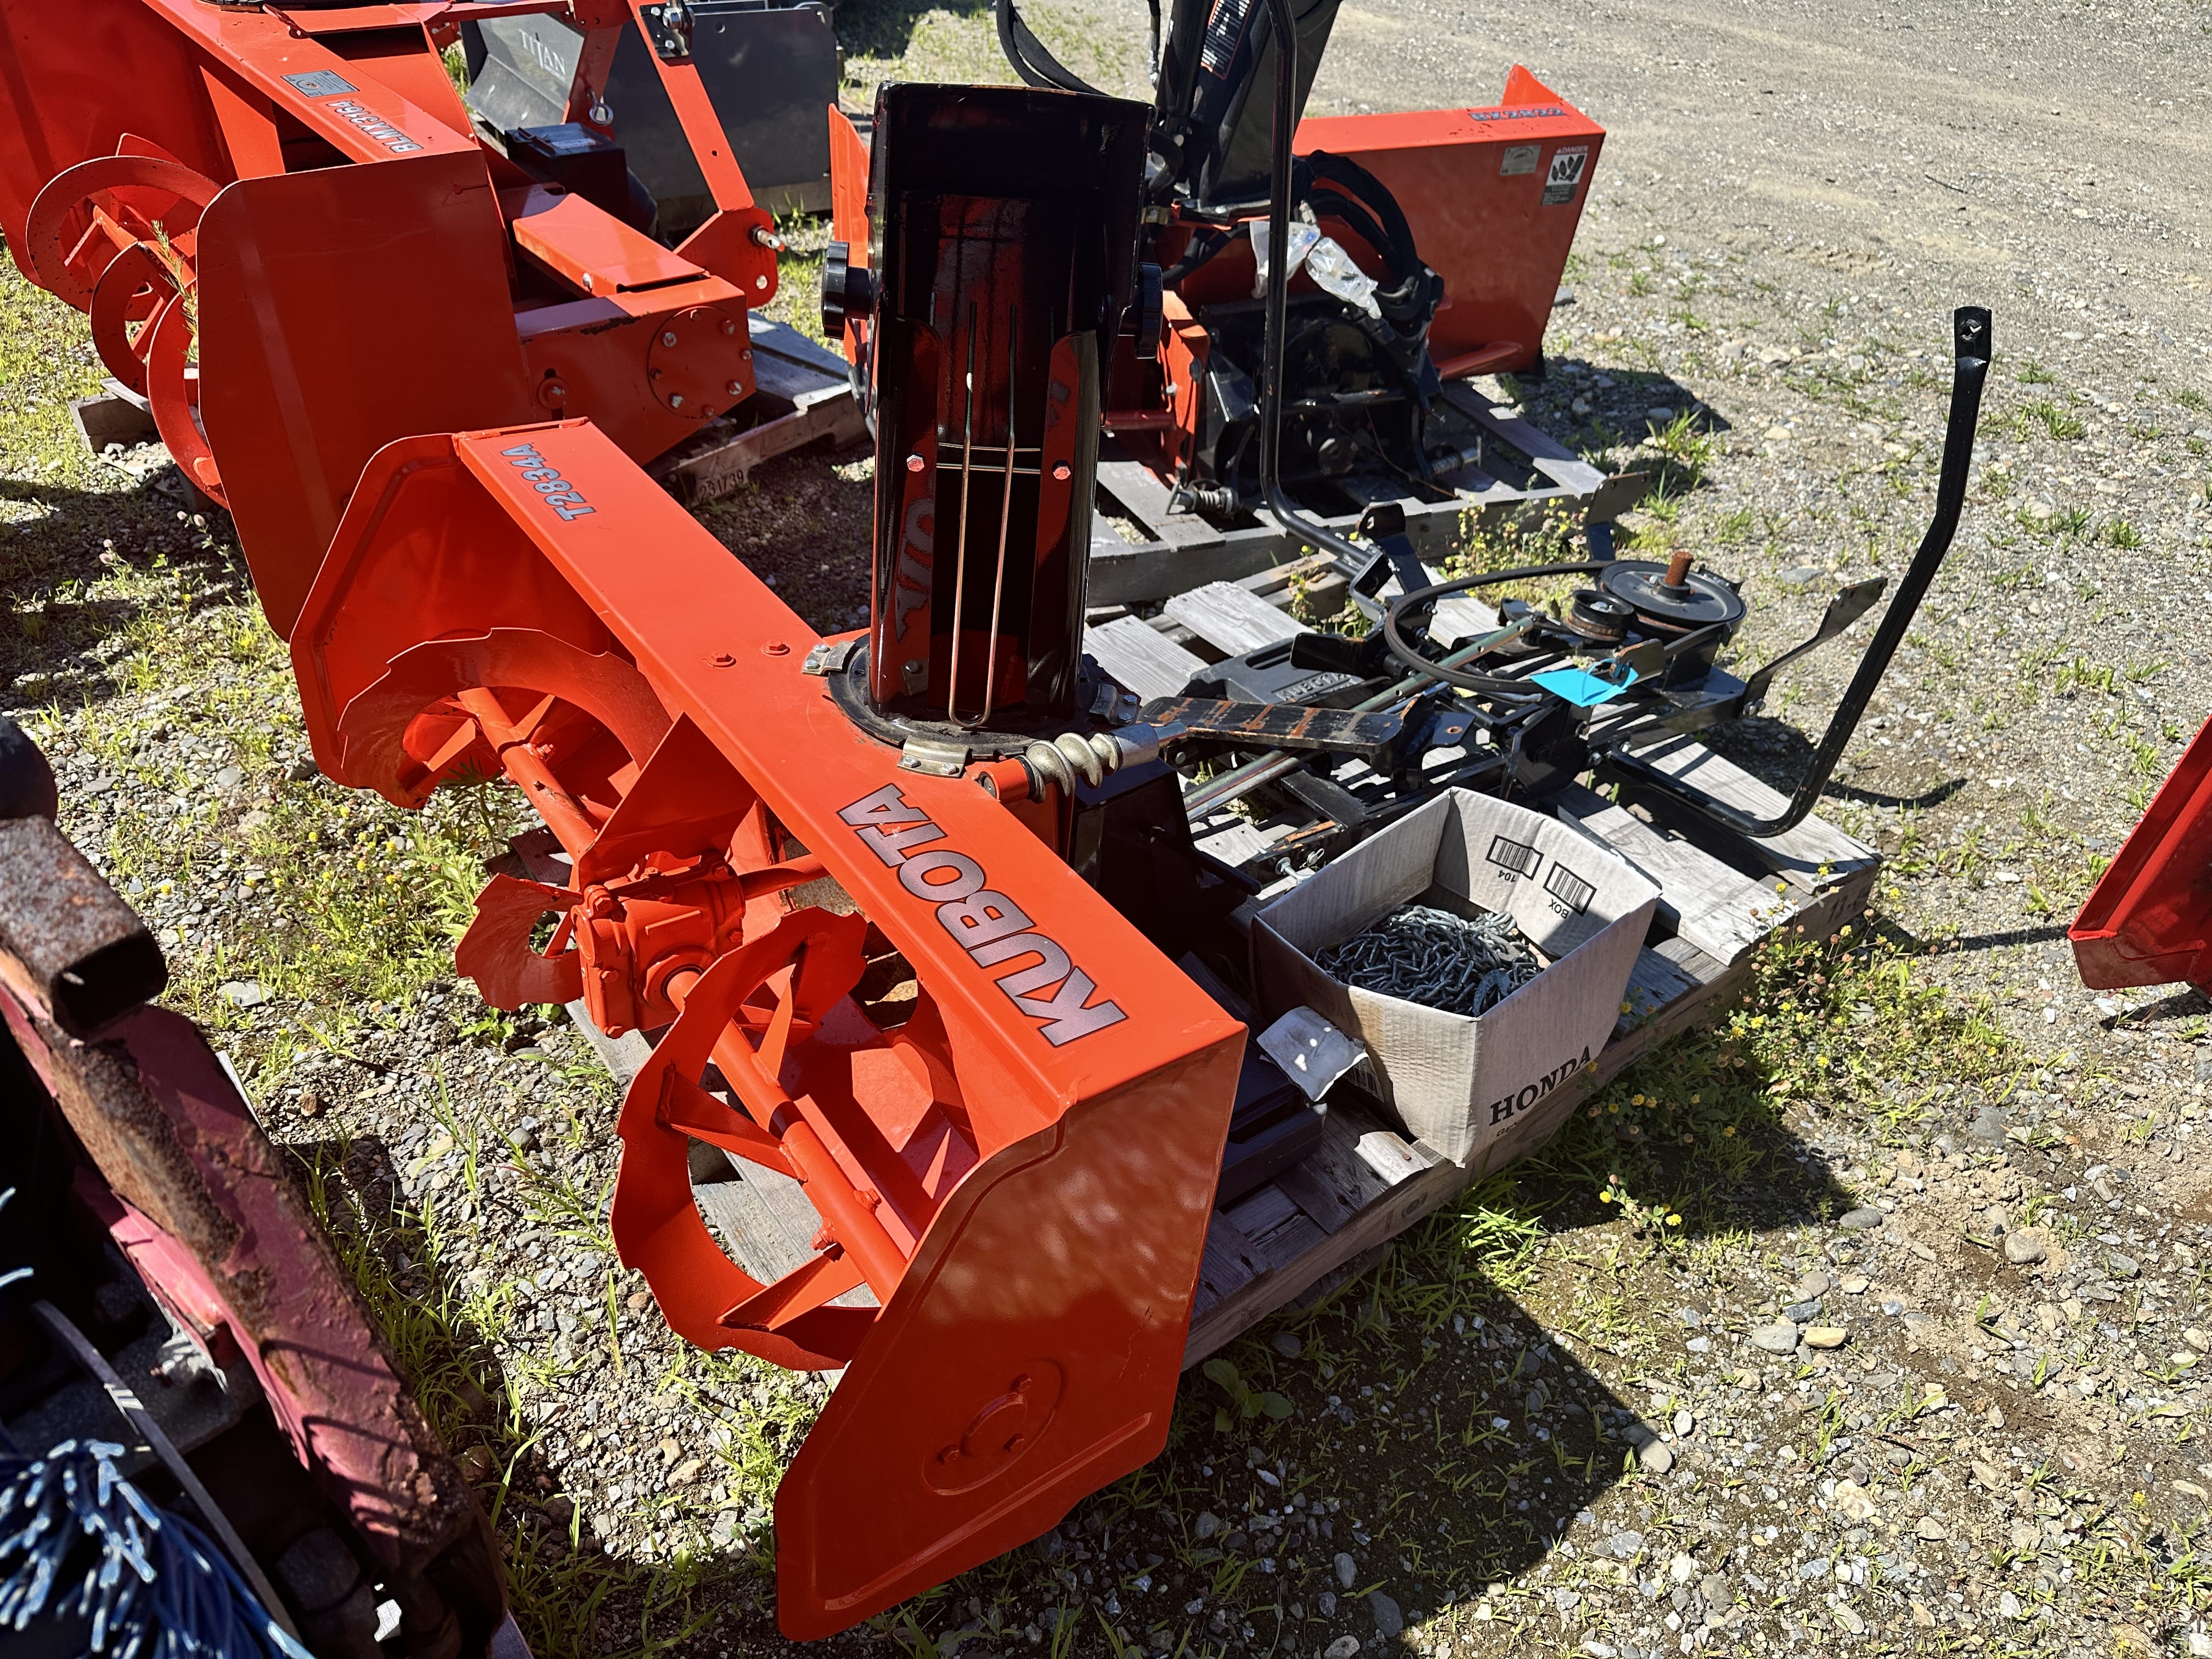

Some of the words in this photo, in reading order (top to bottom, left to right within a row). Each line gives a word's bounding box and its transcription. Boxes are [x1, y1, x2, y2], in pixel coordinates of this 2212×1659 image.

[518, 28, 566, 76] TITAN
[326, 100, 425, 154] BLMX3164
[501, 443, 597, 522] T2834A
[1498, 870, 1516, 883] 104
[836, 782, 1129, 1047] KUBOTA
[1548, 898, 1570, 920] BOX
[1489, 1045, 1591, 1126] HONDA
